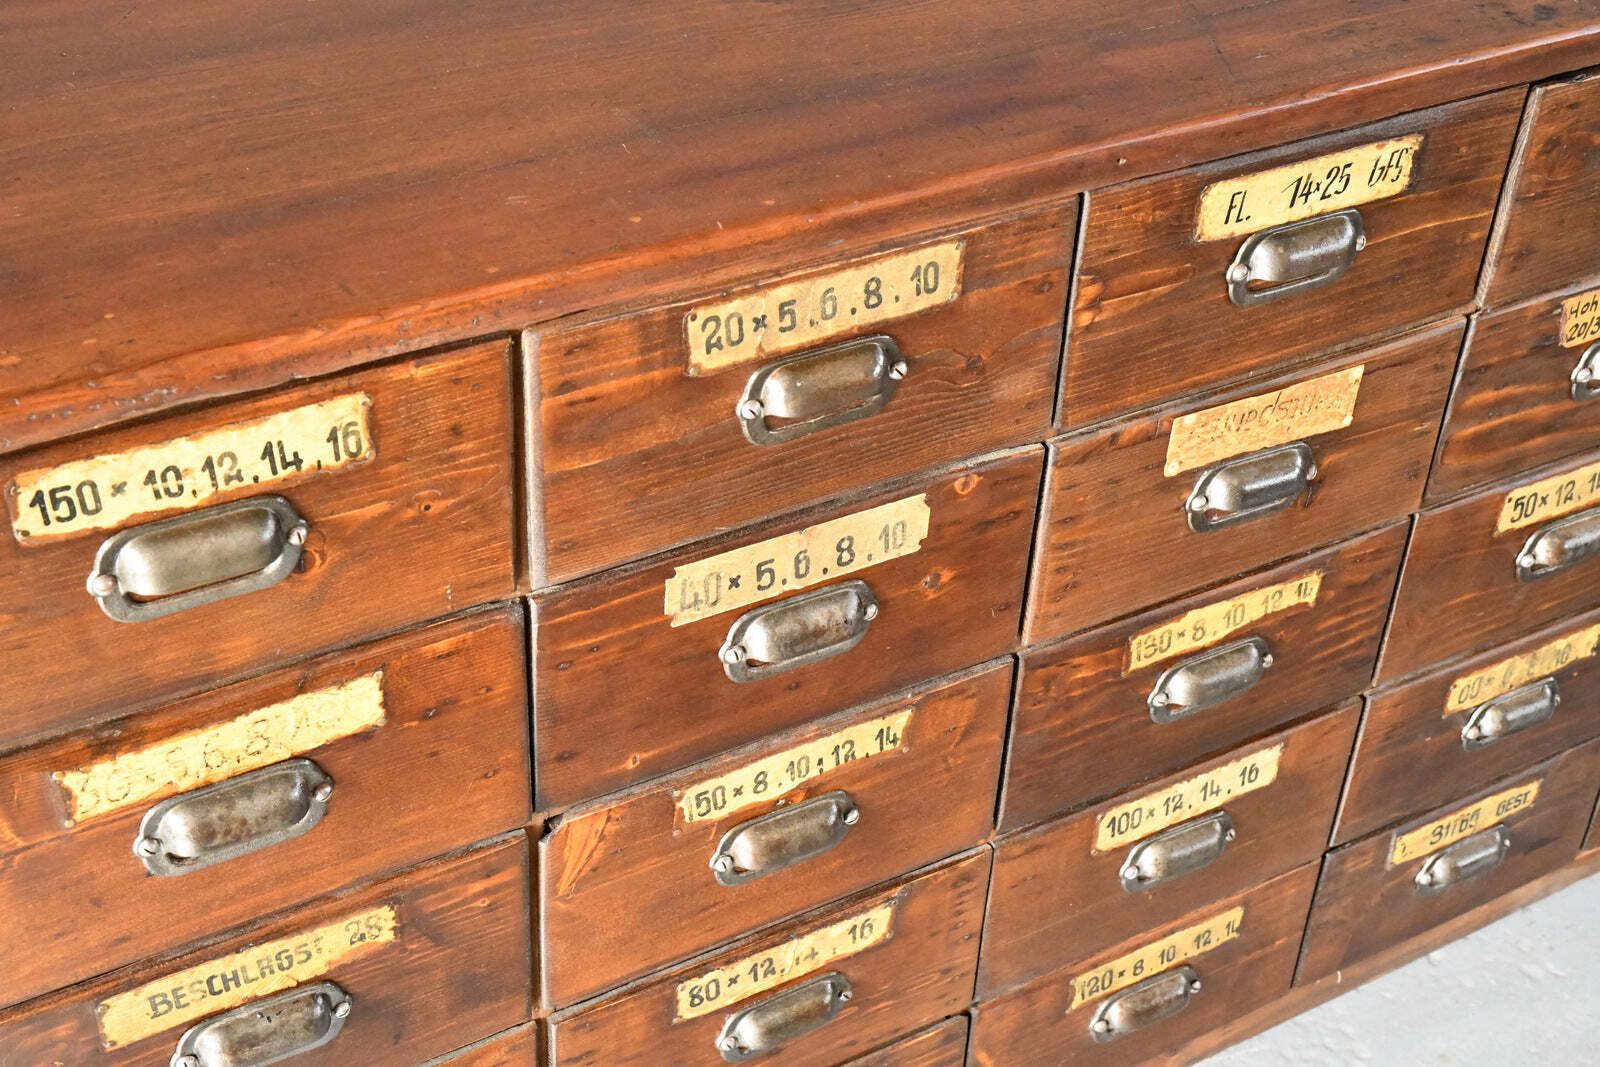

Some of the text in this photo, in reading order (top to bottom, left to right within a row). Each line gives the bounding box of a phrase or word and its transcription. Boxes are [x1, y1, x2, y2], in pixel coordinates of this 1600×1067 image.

[326, 421, 363, 461] 16
[1107, 807, 1143, 838] 100
[1239, 763, 1260, 787] 16
